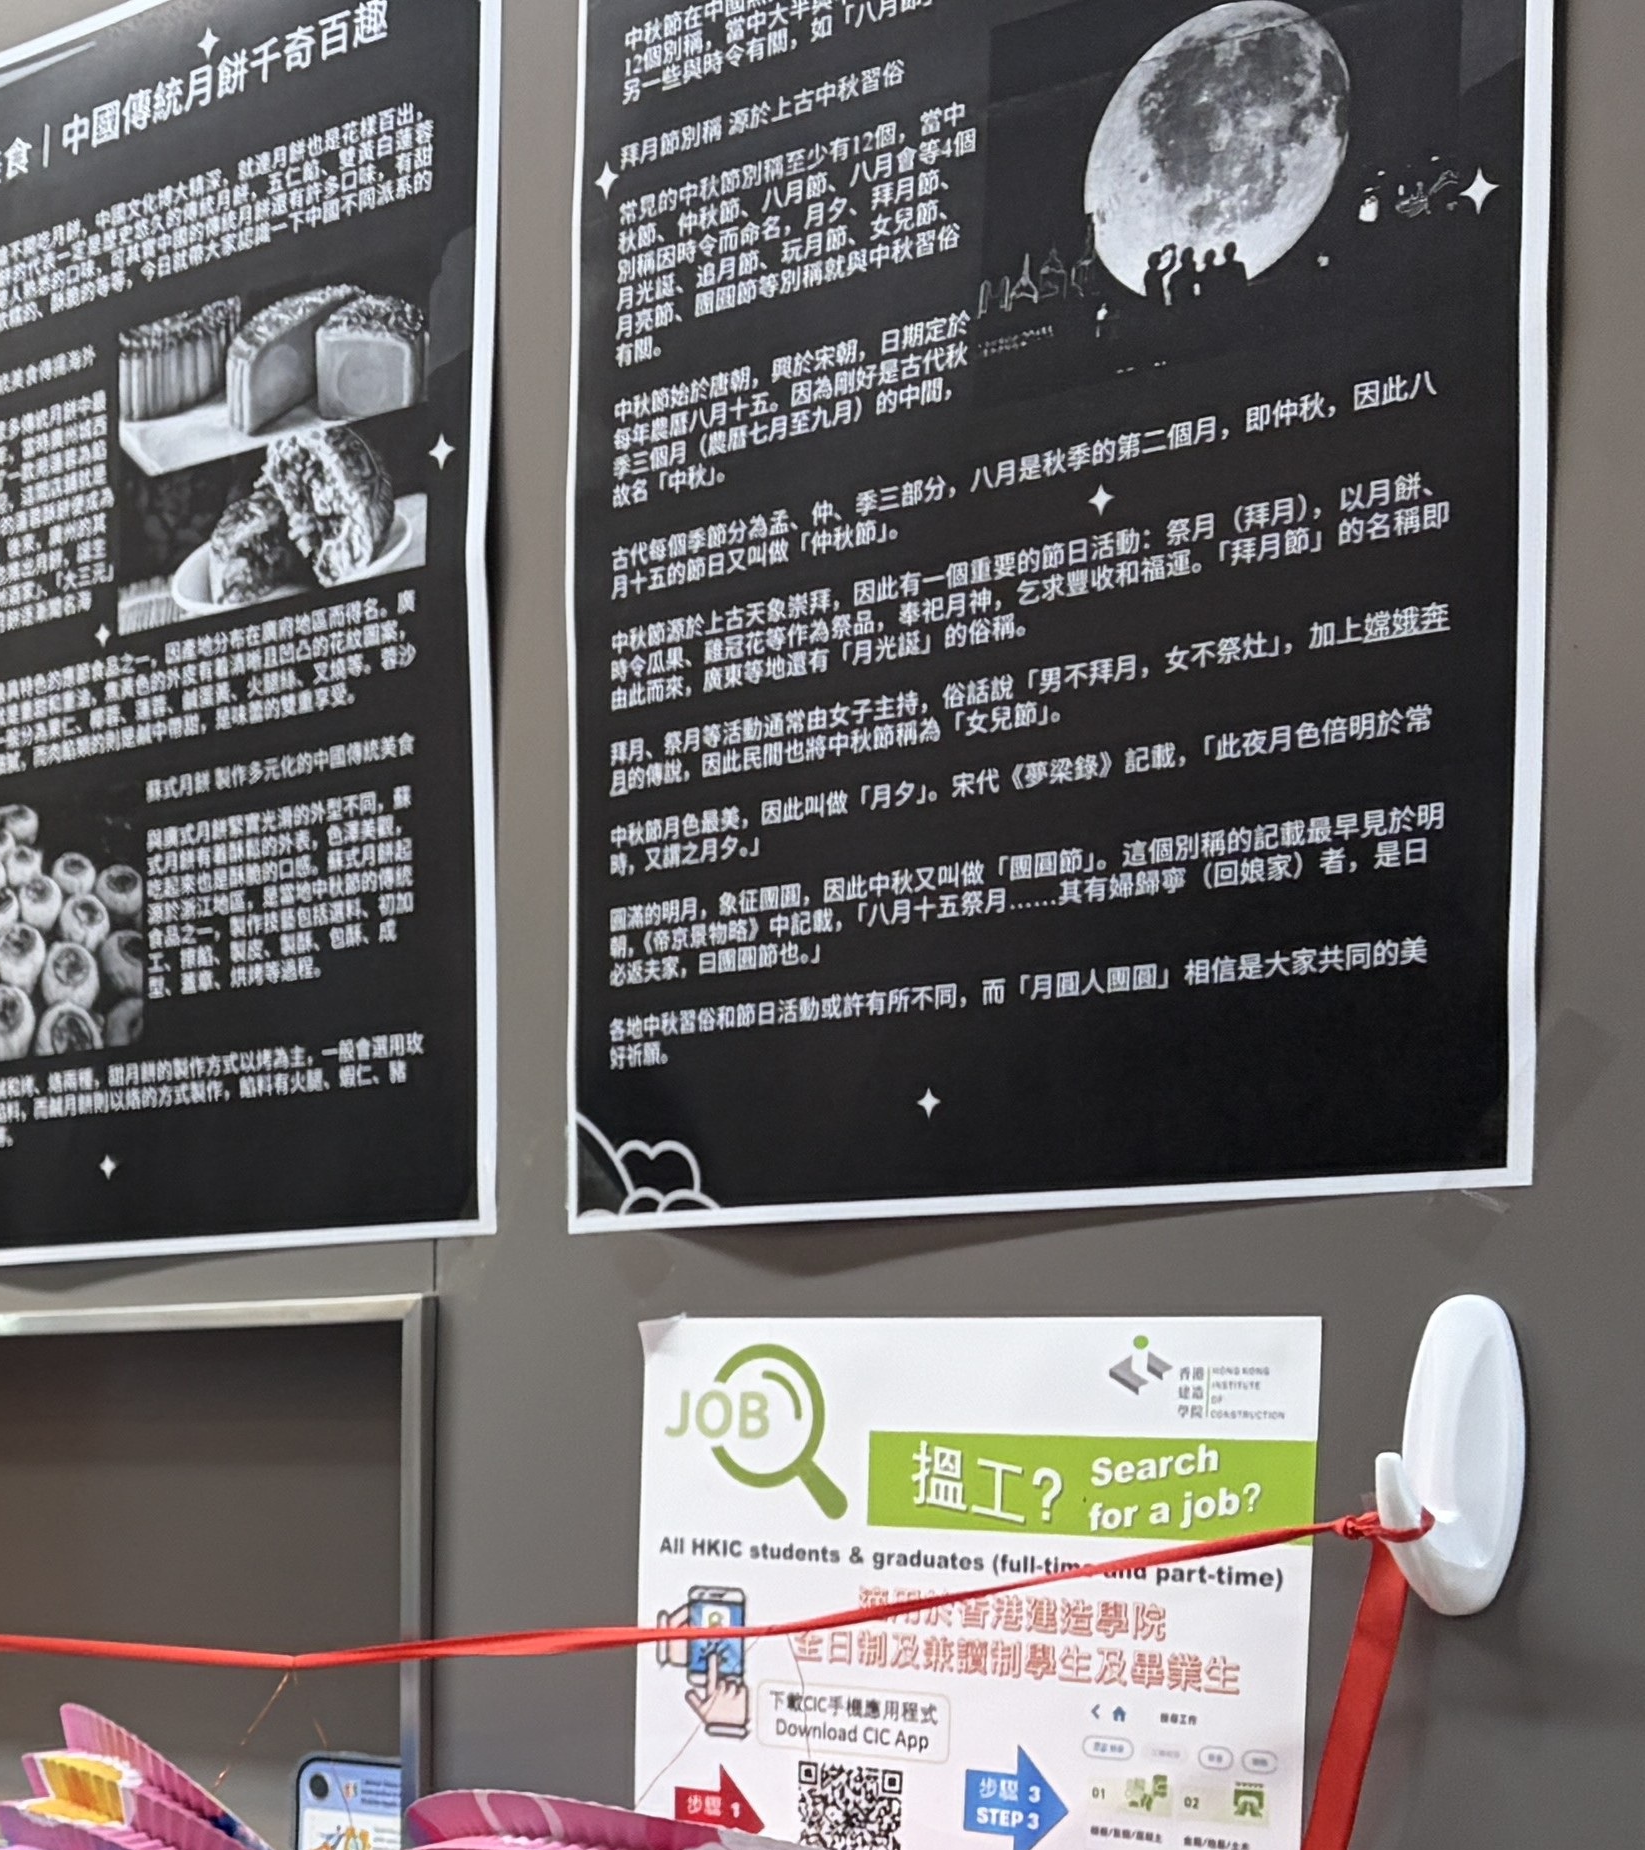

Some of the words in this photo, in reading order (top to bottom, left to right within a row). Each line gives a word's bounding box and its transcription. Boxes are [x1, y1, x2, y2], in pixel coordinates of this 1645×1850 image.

[664, 1389, 771, 1440] JOB
[1089, 1444, 1221, 1488] Search
[1089, 1499, 1139, 1530] for
[1148, 1501, 1172, 1526] a
[1179, 1482, 1263, 1531] job?
[659, 1536, 685, 1555] All
[691, 1538, 743, 1557] HKIC
[749, 1542, 840, 1563] students
[848, 1545, 865, 1564] &
[872, 1547, 985, 1571] graduates
[1156, 1565, 1284, 1592] part-time)
[792, 1629, 1241, 1696] 全日制及兼讀制學生及畢業生
[768, 1690, 939, 1725] 下載CIC手機應用程式
[775, 1719, 857, 1744] Download
[863, 1723, 901, 1745] CIC
[905, 1726, 930, 1752] App
[1027, 1784, 1041, 1803] 3
[975, 1806, 1022, 1829] STEP
[1025, 1811, 1040, 1831] 3
